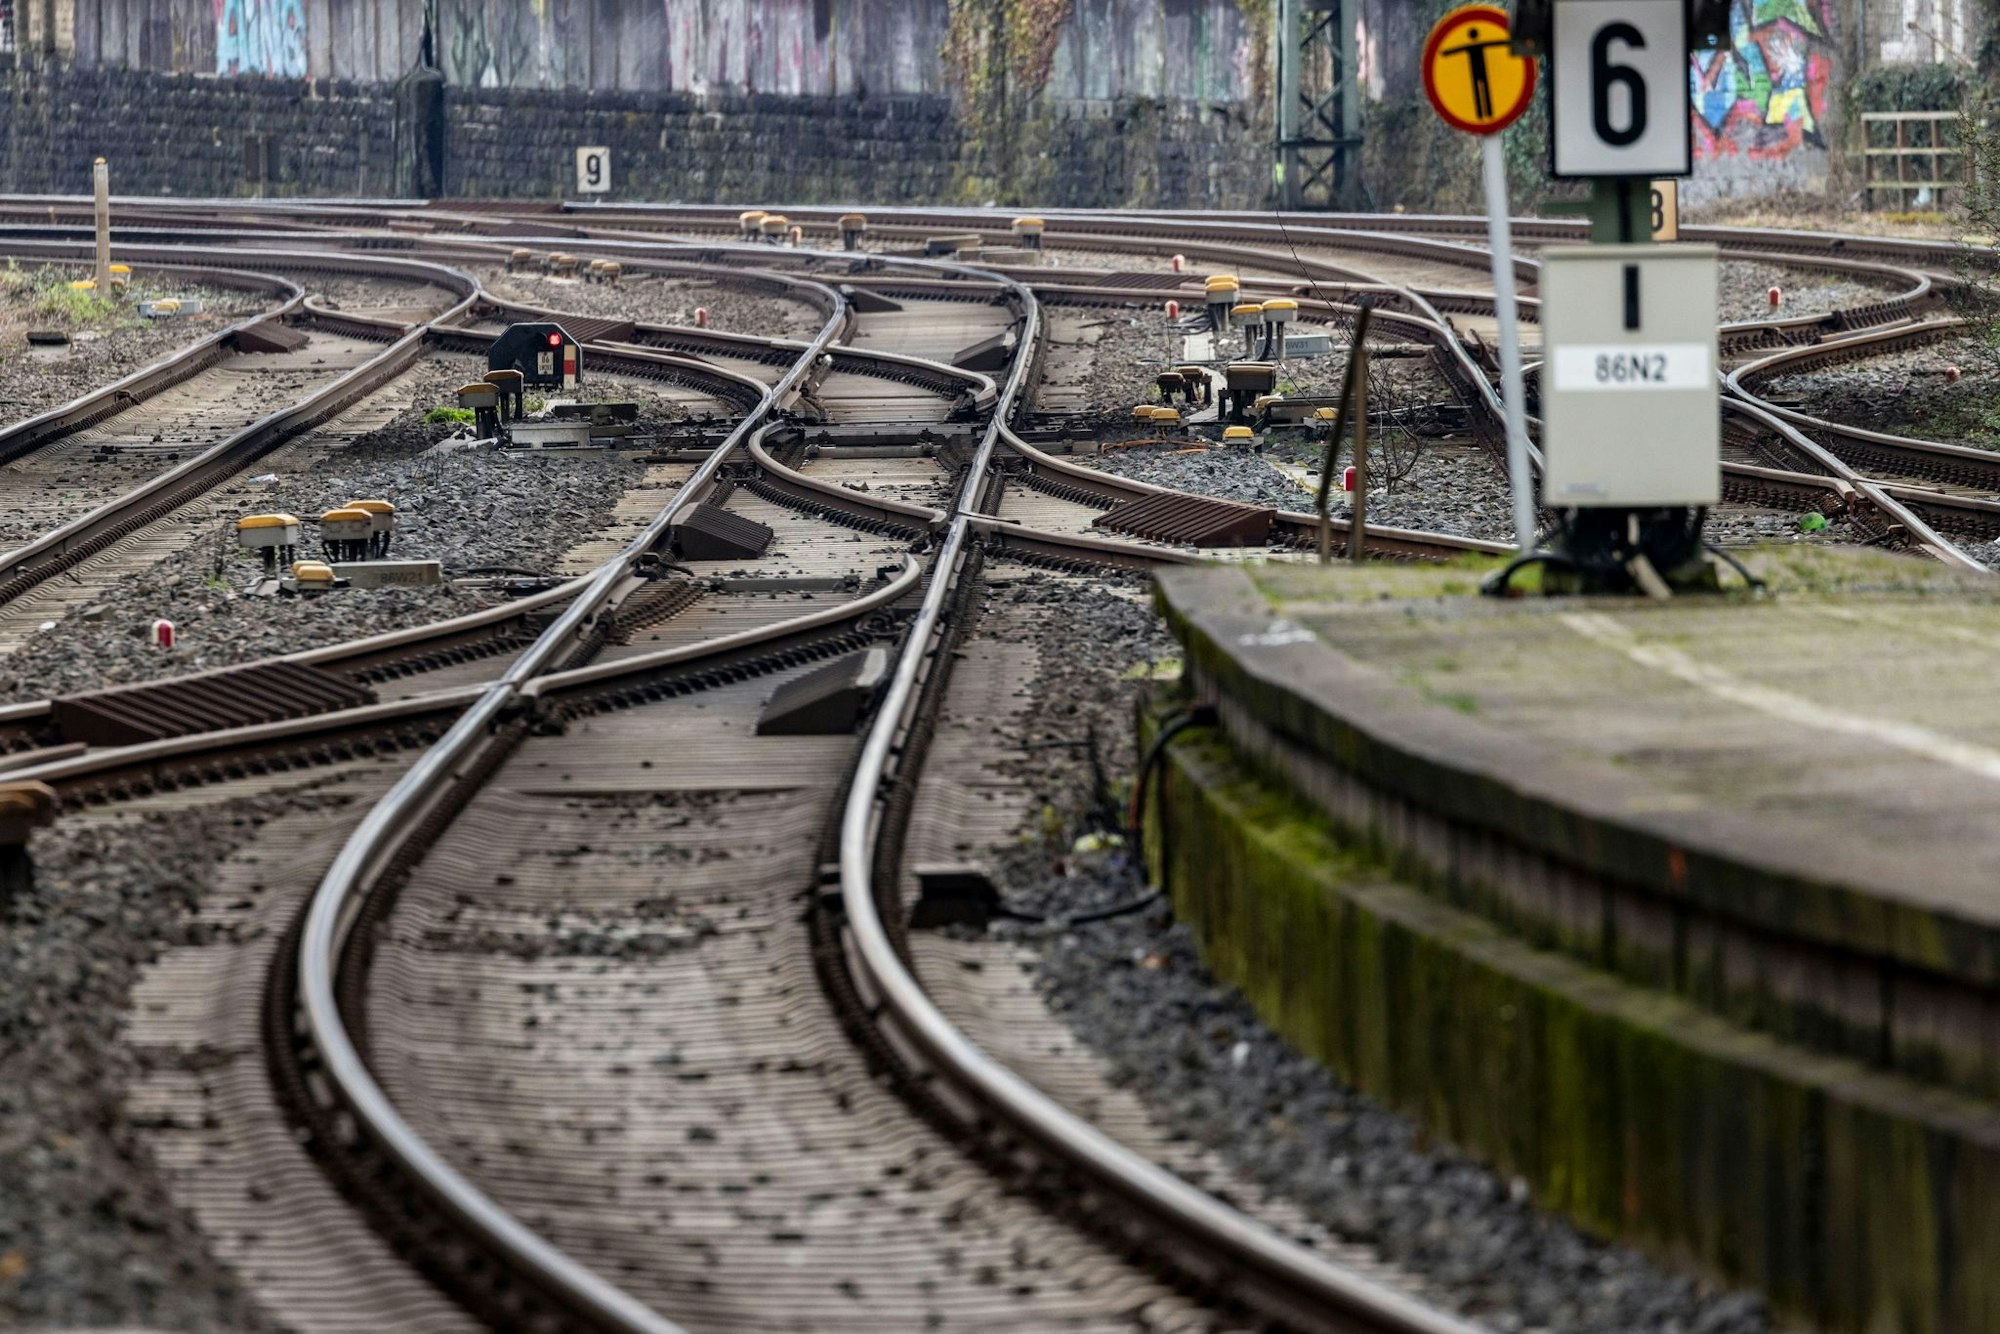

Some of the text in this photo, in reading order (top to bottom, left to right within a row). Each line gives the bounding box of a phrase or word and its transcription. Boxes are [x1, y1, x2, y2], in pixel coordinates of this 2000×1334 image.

[1591, 21, 1647, 148] 6
[586, 154, 601, 186] 9
[1595, 354, 1667, 382] 86N2
[380, 571, 423, 584] 86W21
